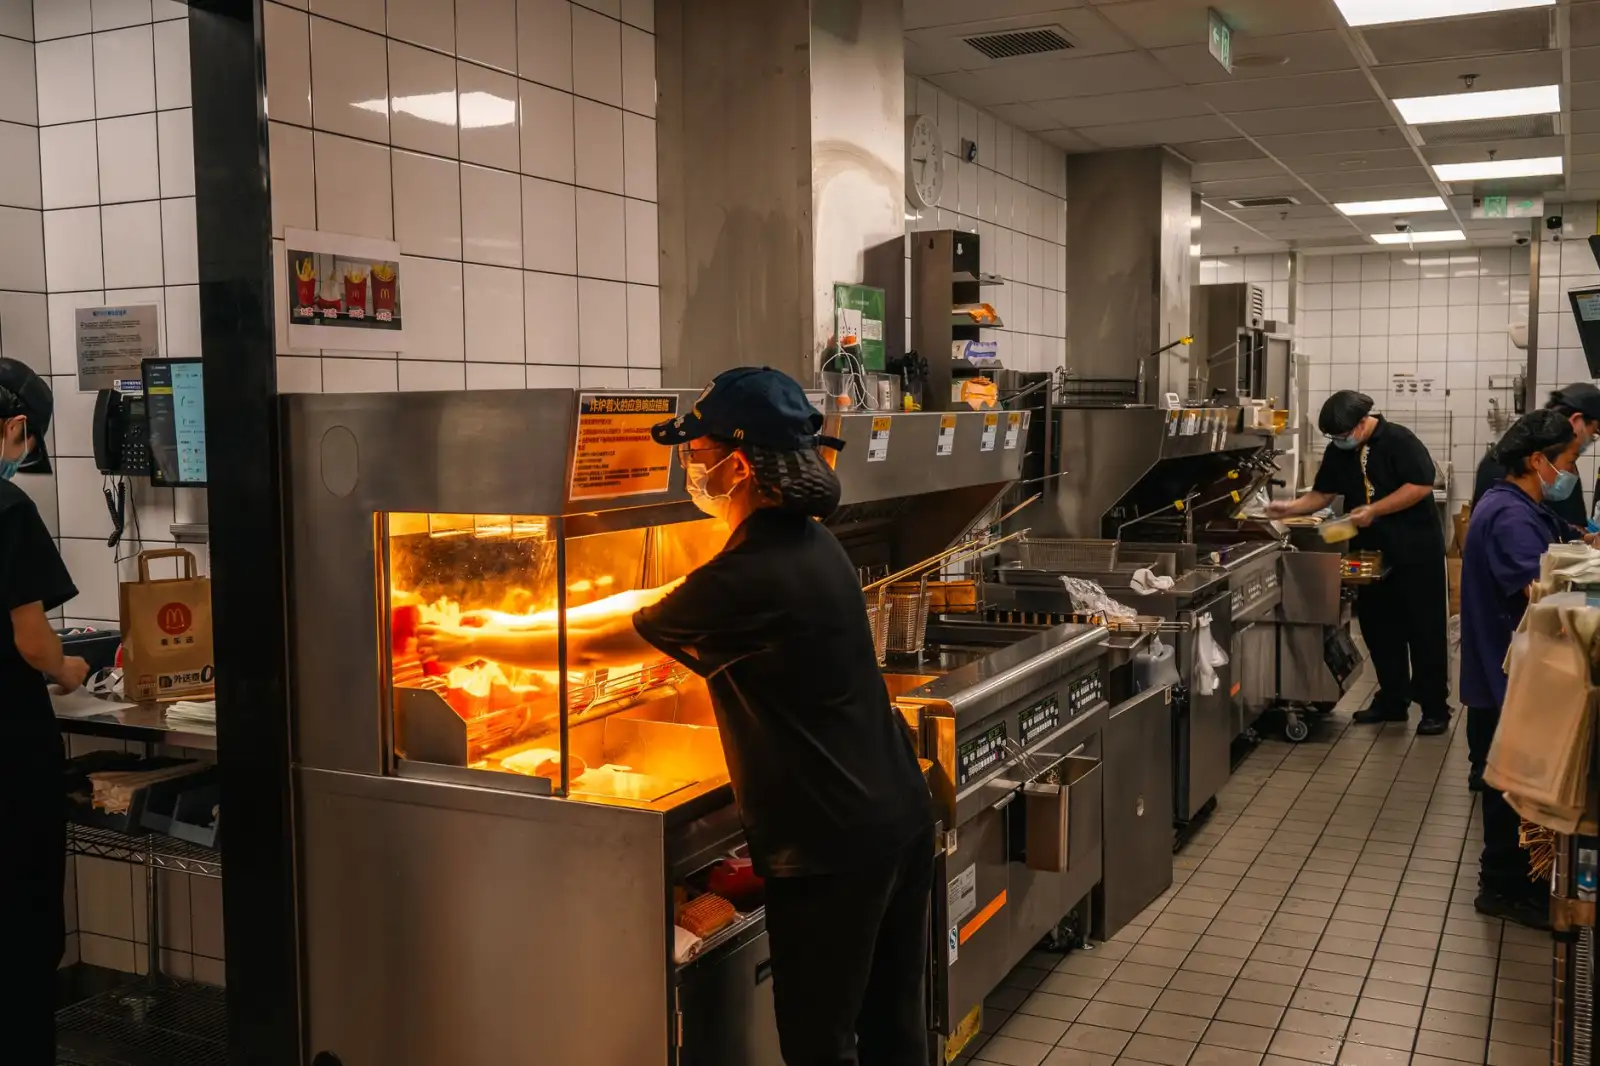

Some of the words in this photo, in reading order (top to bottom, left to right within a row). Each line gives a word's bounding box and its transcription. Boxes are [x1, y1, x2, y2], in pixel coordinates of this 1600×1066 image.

[589, 398, 669, 412] 炸炉着火的应急响应措施
